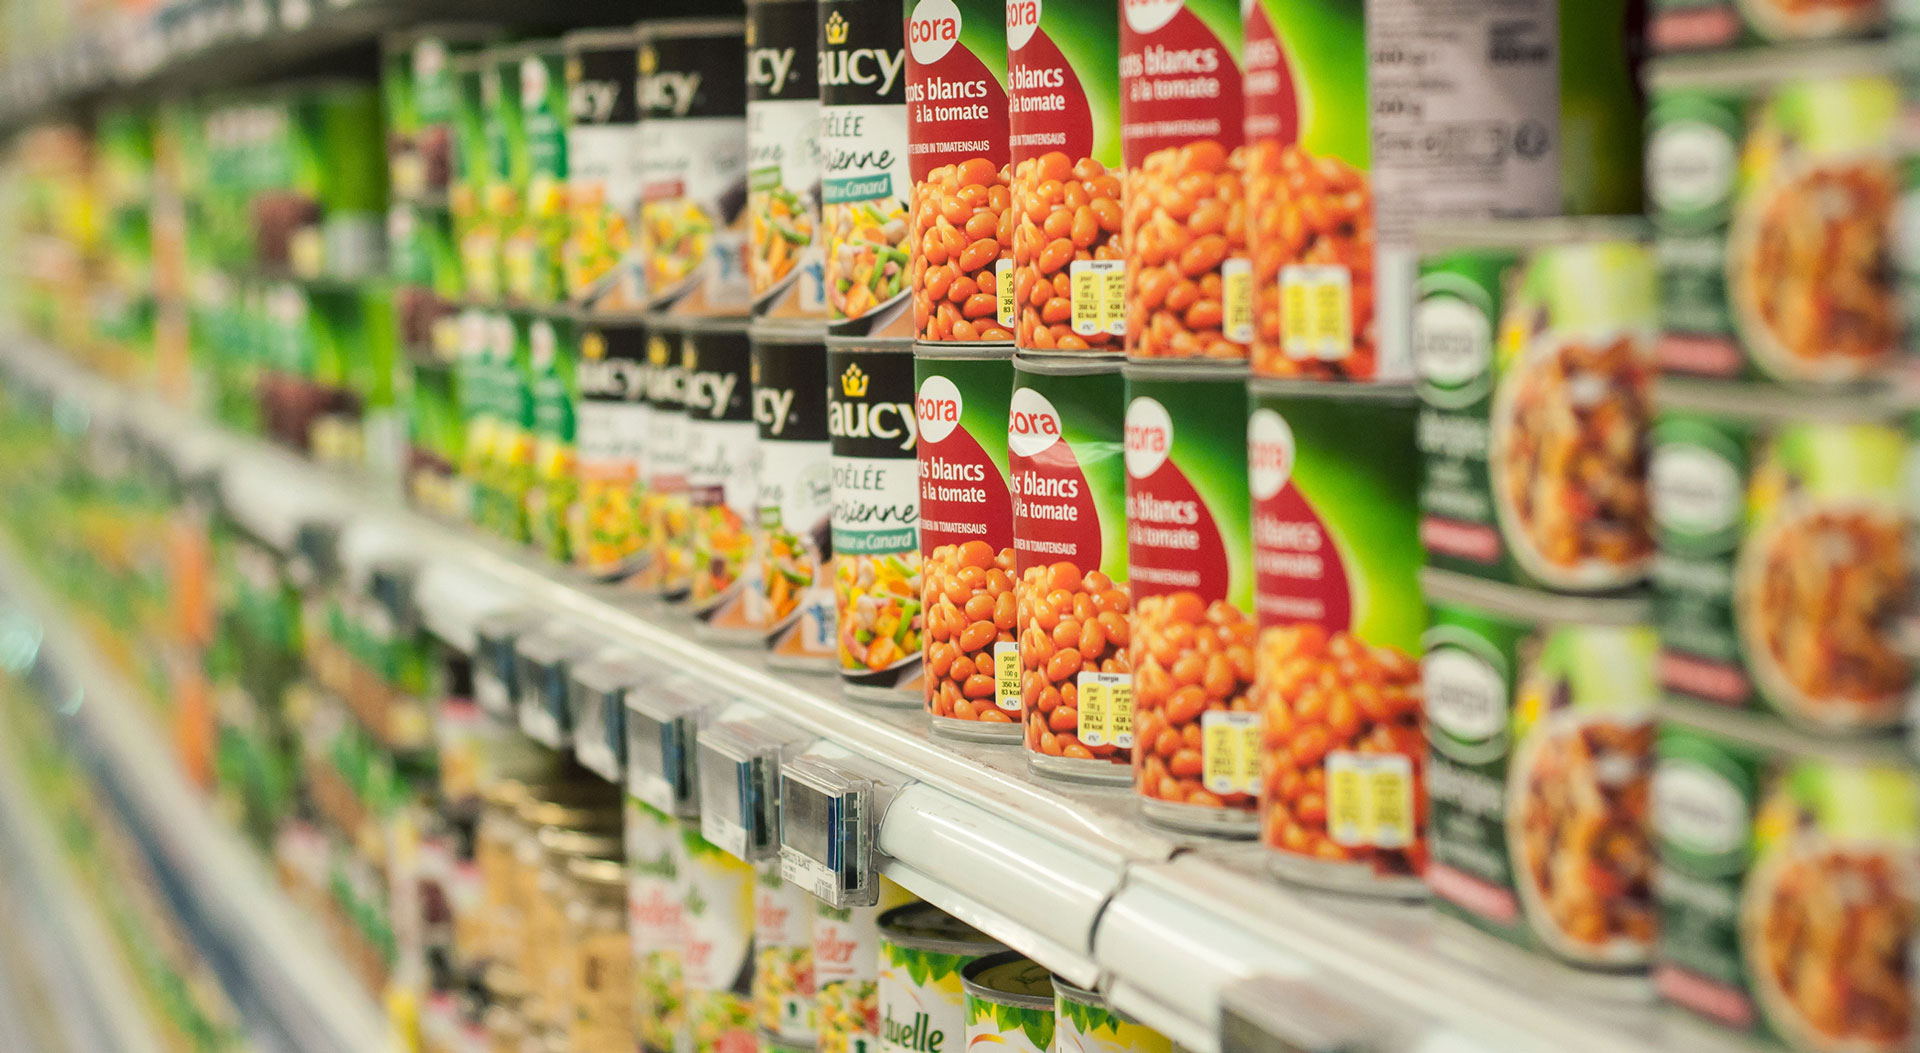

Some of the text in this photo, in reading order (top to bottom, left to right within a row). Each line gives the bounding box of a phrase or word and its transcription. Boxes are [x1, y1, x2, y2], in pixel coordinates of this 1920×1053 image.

[911, 17, 957, 43] cora
[1015, 64, 1064, 89] blancs
[927, 77, 987, 100] blancs
[923, 104, 933, 122] la
[935, 104, 989, 121] tomate
[1021, 93, 1066, 112] tomate
[936, 140, 990, 153] TOMATENSAUS
[919, 399, 957, 422] cora
[932, 456, 984, 481] blancs
[922, 481, 986, 503] à la tomate
[1024, 470, 1078, 498] blancs
[1030, 501, 1078, 522] tomate
[939, 521, 987, 535] TOMATENSAUS
[1031, 540, 1077, 556] TOMATENSAUS
